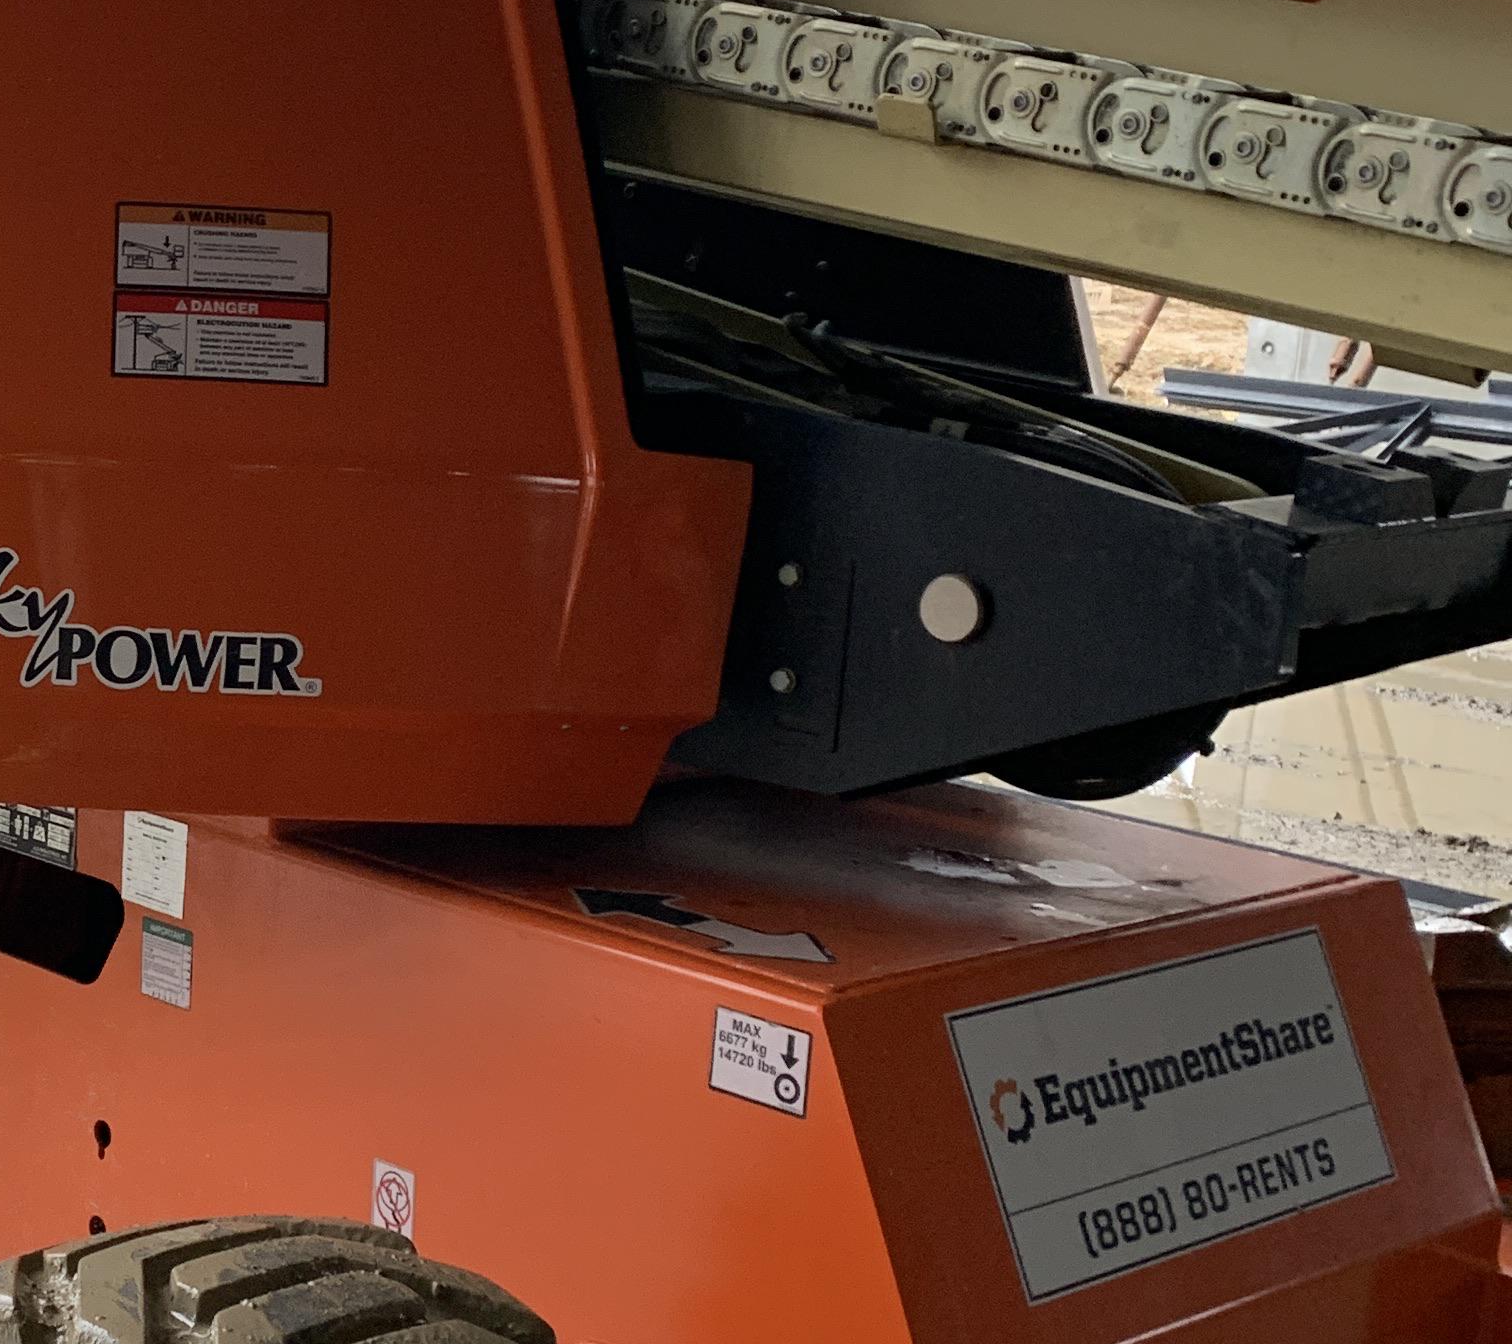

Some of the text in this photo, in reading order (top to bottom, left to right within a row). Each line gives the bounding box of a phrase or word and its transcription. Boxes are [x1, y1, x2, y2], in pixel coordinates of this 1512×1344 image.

[189, 210, 268, 227] WARNING
[191, 299, 259, 315] DANGER
[732, 1018, 762, 1039] MAX
[718, 1029, 768, 1058] 6677 kg
[717, 1047, 778, 1076] 14720 lbs
[1033, 1011, 1335, 1127] EquipmentShare
[1078, 1137, 1336, 1258] (888) 80-RENTS
